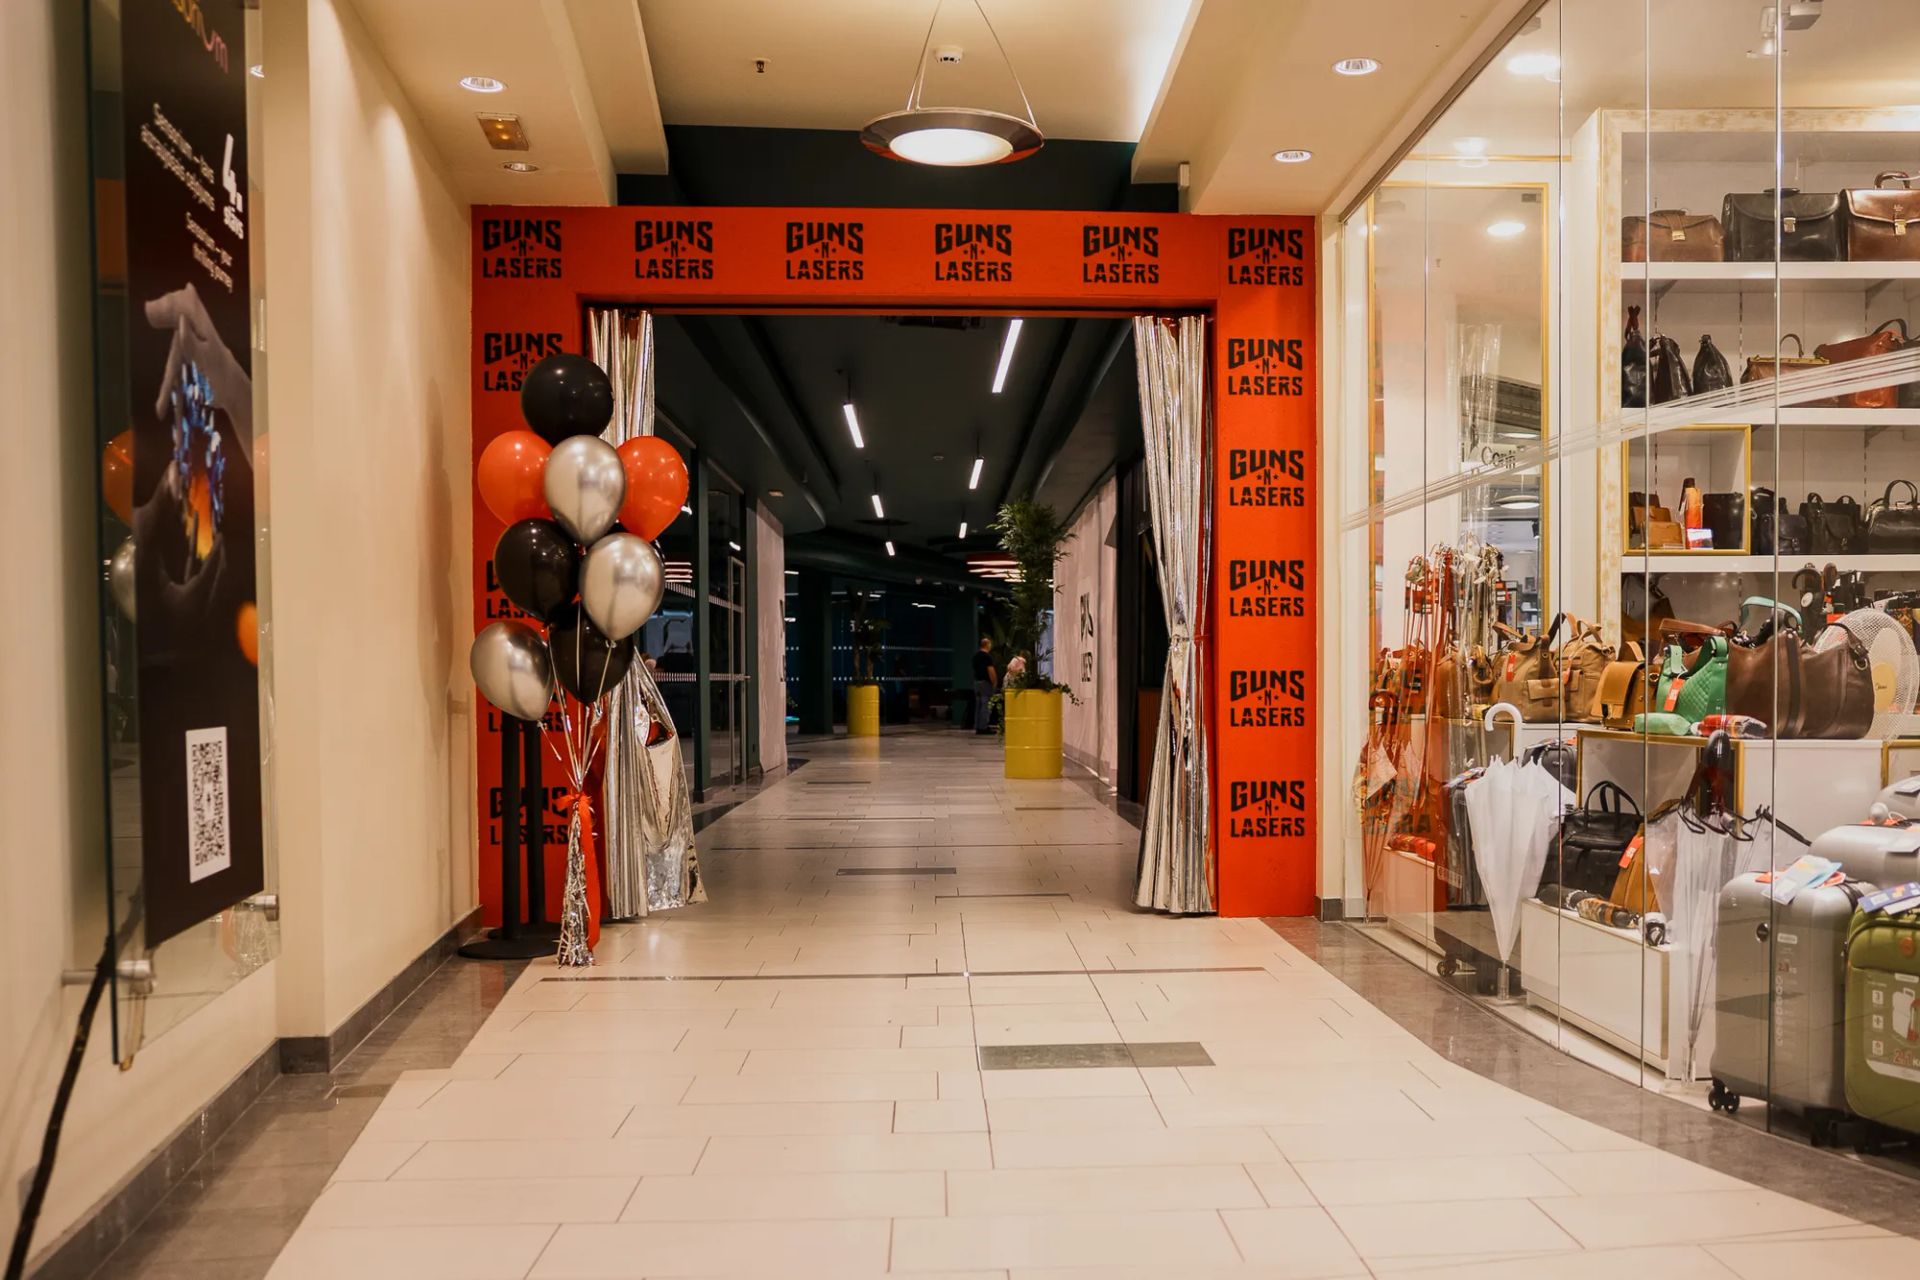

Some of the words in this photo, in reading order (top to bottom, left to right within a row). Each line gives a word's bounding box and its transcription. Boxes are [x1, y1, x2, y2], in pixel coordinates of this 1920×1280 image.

[481, 218, 562, 252] GUNS
[634, 219, 713, 253] GUNS
[785, 221, 864, 254] GUNS
[934, 223, 1012, 257] GUNS
[1083, 225, 1159, 258] GUNS
[1227, 227, 1304, 261] GUNS
[518, 239, 527, 257] N
[670, 240, 679, 258] N
[821, 241, 830, 259] N
[970, 243, 978, 260] N
[1117, 245, 1126, 262] N
[1262, 247, 1270, 264] N
[482, 257, 562, 279] LASERS
[634, 258, 714, 280] LASERS
[785, 259, 864, 281] LASERS
[935, 260, 1012, 282] LASERS
[1083, 262, 1160, 284] LASERS
[1228, 264, 1304, 286] LASERS
[484, 332, 562, 365] GUNS
[1227, 338, 1303, 371] GUNS
[1262, 357, 1270, 374] N
[484, 370, 528, 392] LAS
[1228, 375, 1303, 396] LASERS
[1229, 449, 1305, 482] GUNS
[1263, 469, 1271, 485] N
[1229, 486, 1305, 507] LASERS
[1229, 559, 1305, 591] GUNS
[1263, 579, 1271, 595] N
[1229, 596, 1305, 617] LASERS
[1230, 669, 1305, 702] GUNS
[1264, 689, 1272, 706] N
[1230, 706, 1305, 727] LASERS
[1230, 780, 1305, 812] GUNS
[1264, 799, 1272, 816] N
[1230, 817, 1306, 838] LASERS
